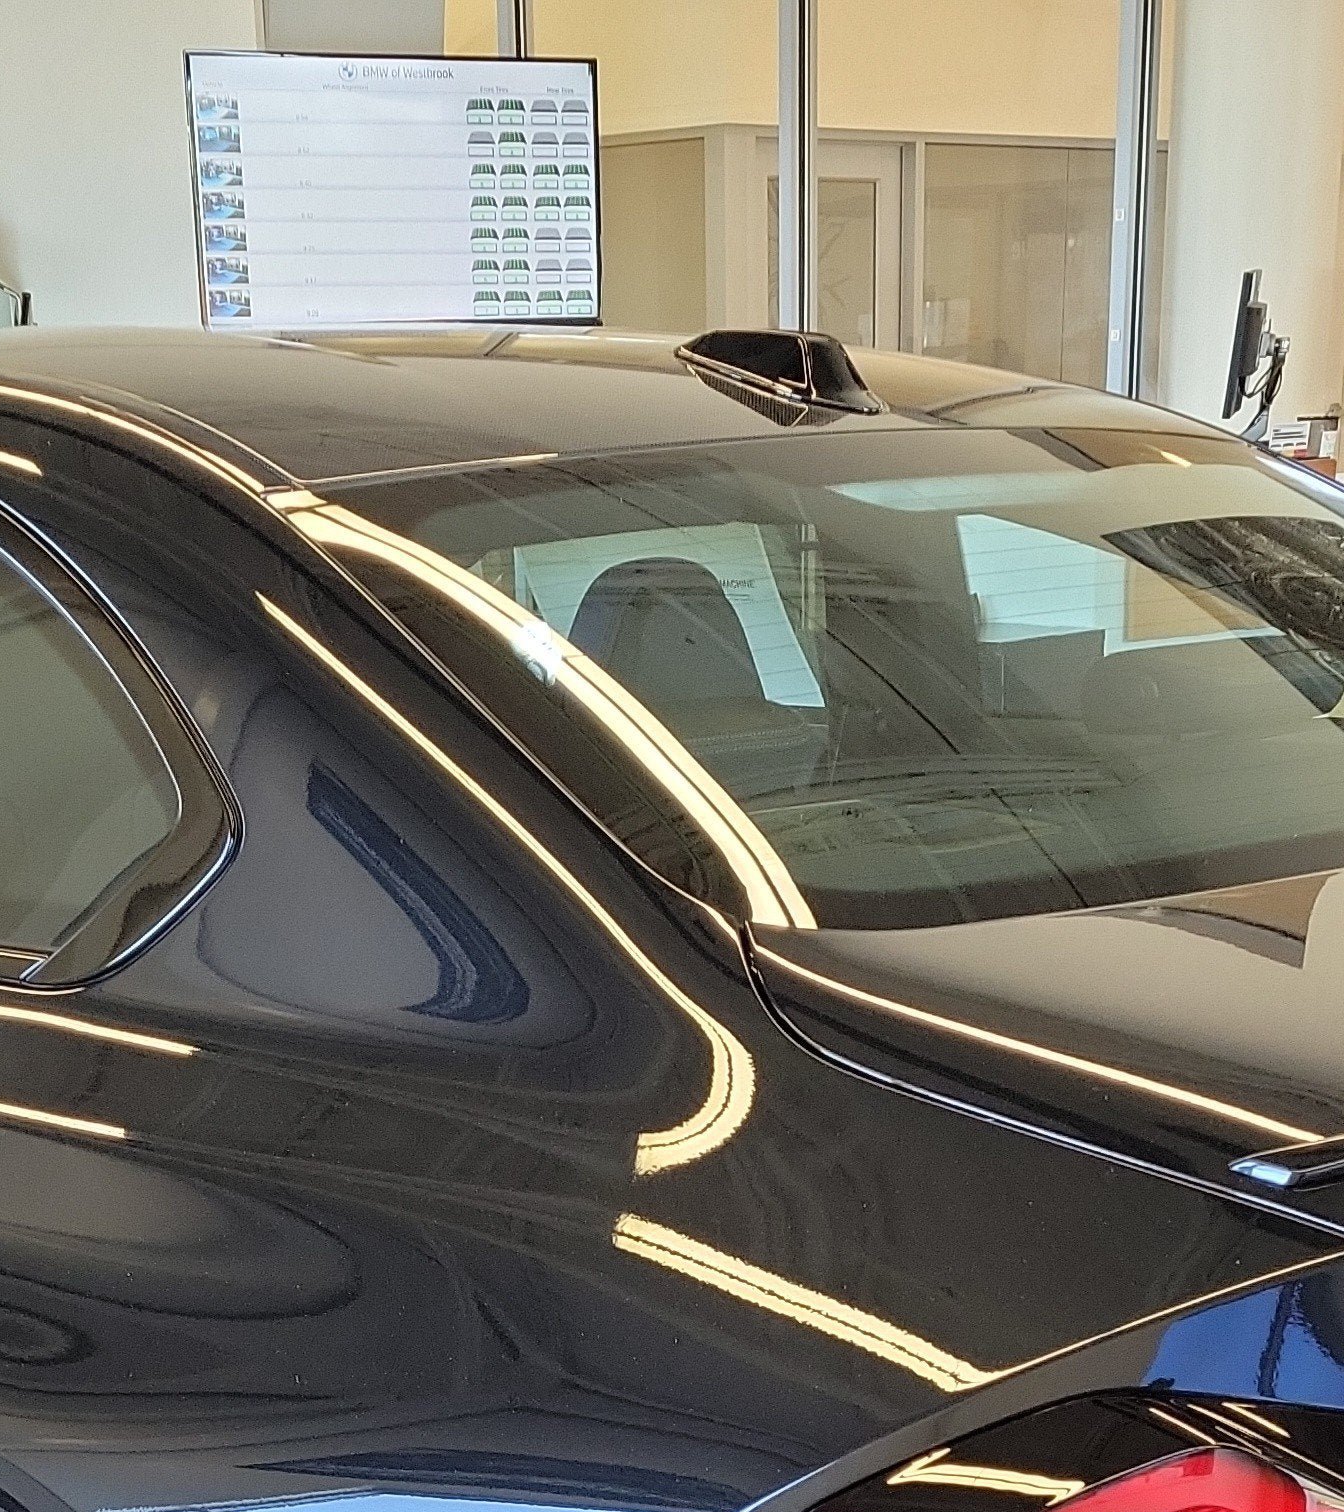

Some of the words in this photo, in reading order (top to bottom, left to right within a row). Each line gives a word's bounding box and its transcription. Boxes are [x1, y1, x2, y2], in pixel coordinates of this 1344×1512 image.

[362, 65, 389, 78] BMW
[391, 66, 401, 78] of
[402, 66, 455, 79] Westbrook
